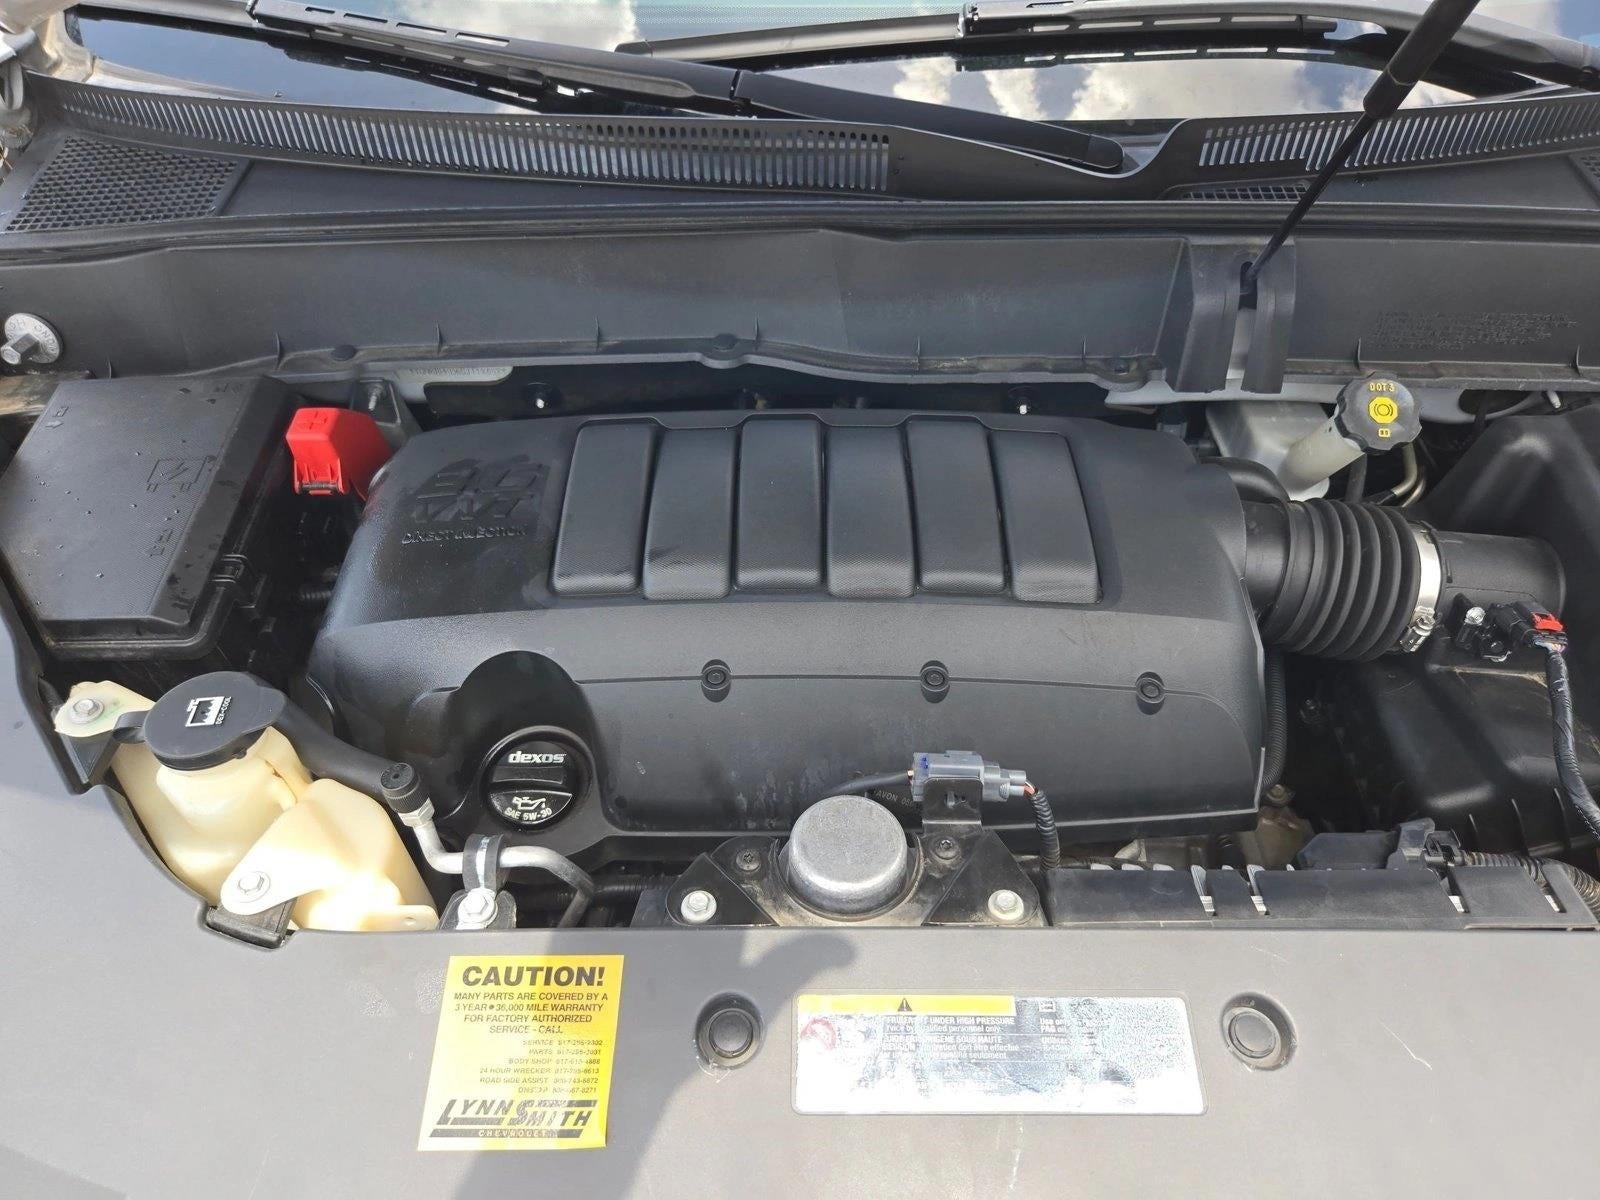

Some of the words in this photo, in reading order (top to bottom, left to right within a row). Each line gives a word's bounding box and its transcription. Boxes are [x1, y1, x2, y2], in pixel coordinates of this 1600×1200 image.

[1369, 382, 1386, 391] DOT
[1388, 382, 1395, 392] 3
[508, 750, 566, 764] dexos
[504, 807, 521, 820] SAE
[523, 807, 553, 821] 5W-30
[462, 966, 606, 987] CAUTION!
[453, 992, 480, 1001] MANY
[483, 992, 514, 1001] PARTS
[517, 992, 536, 1001] ARE
[538, 992, 584, 1001] COVERED
[586, 992, 599, 1001] BY
[601, 992, 609, 1001] A
[455, 1004, 460, 1012] 3
[462, 1003, 487, 1012] YEAR
[495, 1003, 524, 1014] 36,000
[526, 1003, 548, 1012] MILE
[550, 1003, 604, 1012] WARRANTY
[464, 1014, 484, 1023] FOR
[486, 1014, 529, 1023] FACTORY
[532, 1014, 593, 1023] AUTHORIZED
[976, 1016, 1015, 1026] PRESSURE
[489, 1025, 529, 1034] SERVICE
[538, 1025, 563, 1034] CALL
[436, 1099, 514, 1126] LYNN
[507, 1099, 593, 1127] SMITH
